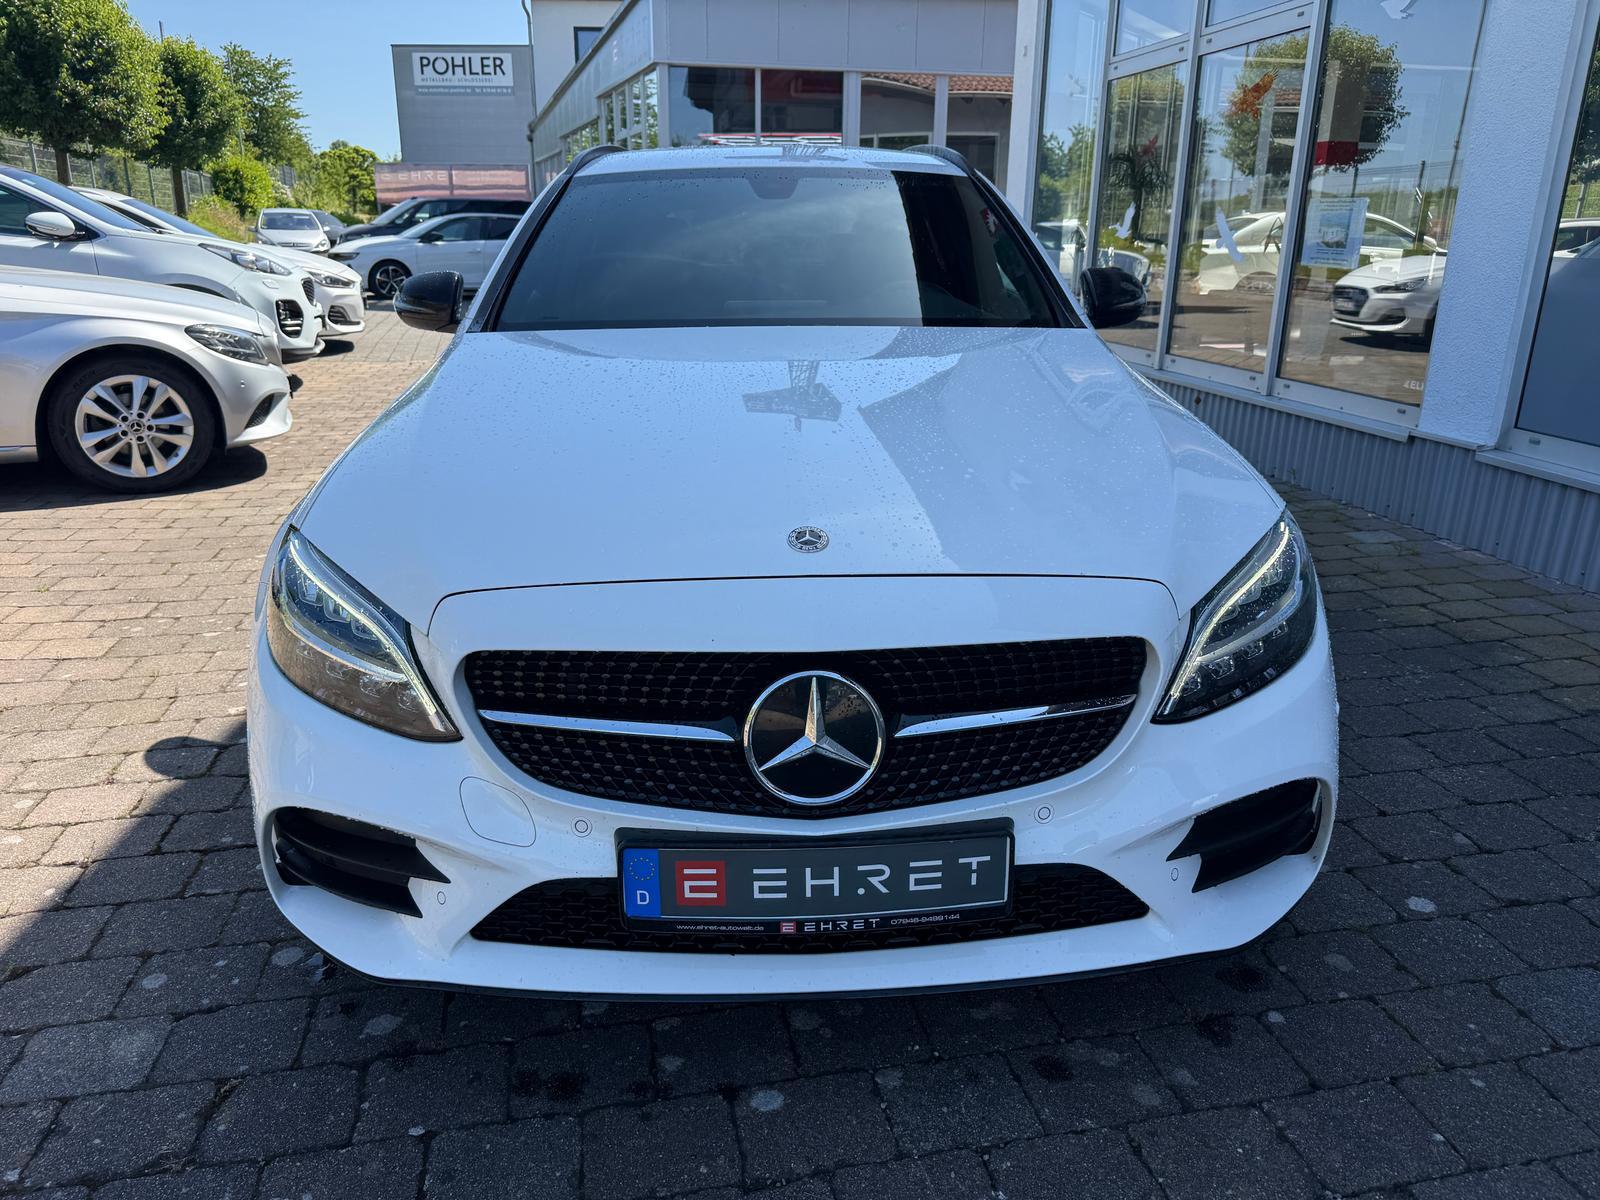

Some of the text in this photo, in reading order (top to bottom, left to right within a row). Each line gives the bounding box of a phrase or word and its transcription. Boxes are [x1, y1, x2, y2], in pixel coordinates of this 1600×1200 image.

[752, 855, 991, 899] EHRET
[636, 890, 650, 905] D
[804, 918, 880, 932] EHRET
